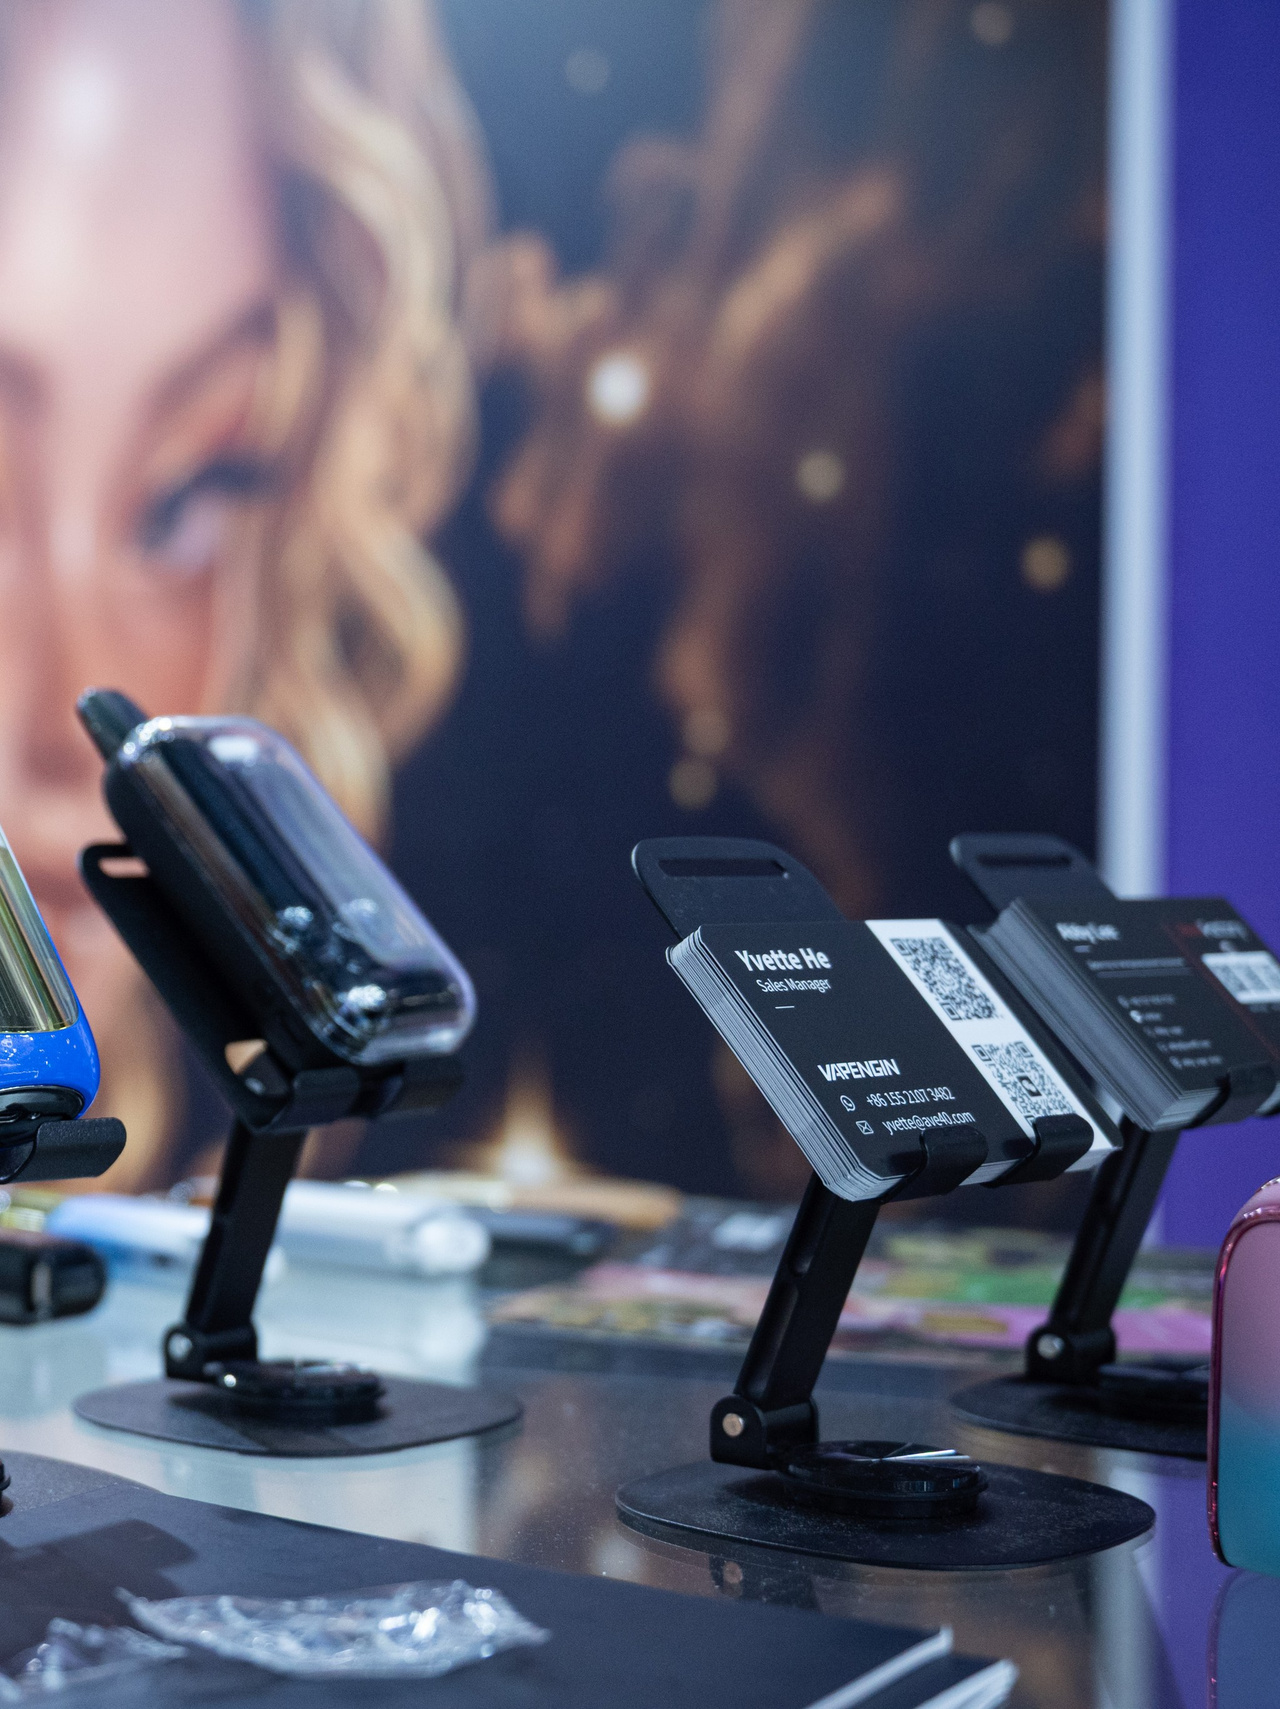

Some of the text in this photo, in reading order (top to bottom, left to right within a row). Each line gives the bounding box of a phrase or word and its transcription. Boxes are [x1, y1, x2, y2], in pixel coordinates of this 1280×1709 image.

[734, 947, 832, 972] Yvette He
[756, 977, 832, 994] Sales Manager
[817, 1058, 901, 1082] VAPENGIN
[866, 1086, 956, 1107] +86 155 2107 3482
[882, 1110, 977, 1136] yvette@ave40.com
